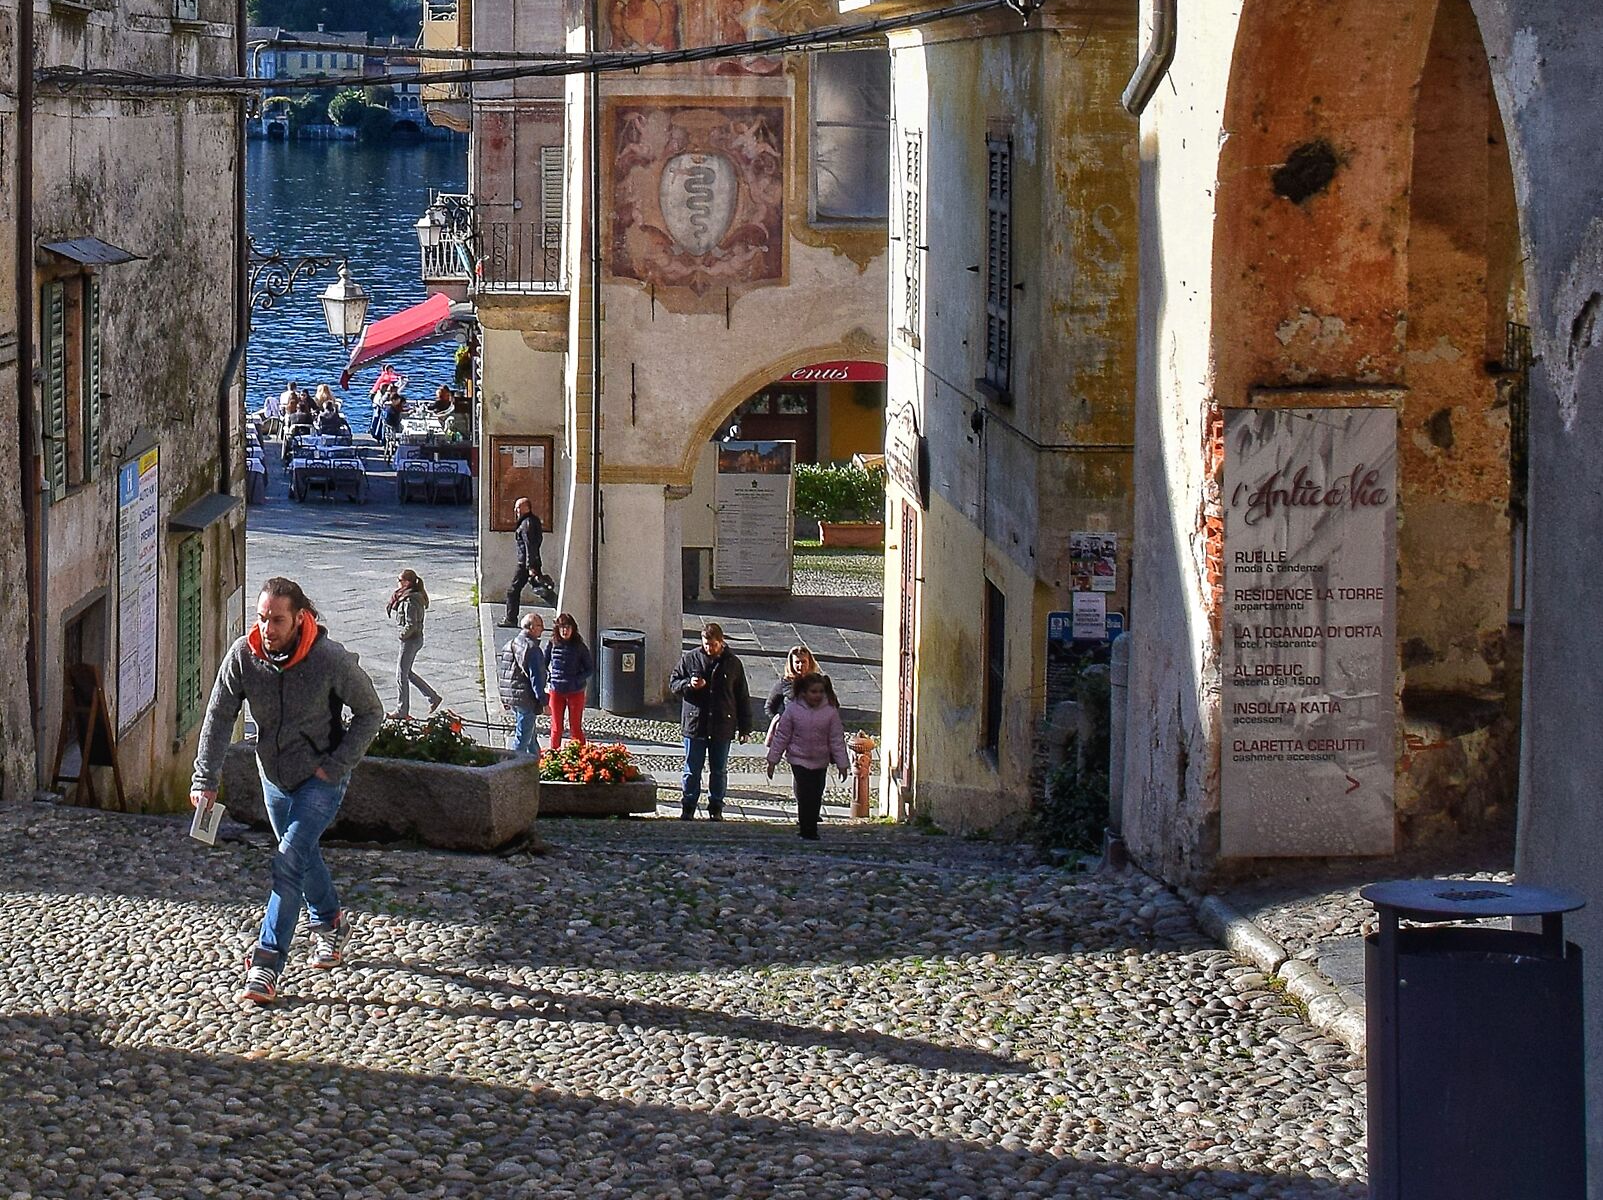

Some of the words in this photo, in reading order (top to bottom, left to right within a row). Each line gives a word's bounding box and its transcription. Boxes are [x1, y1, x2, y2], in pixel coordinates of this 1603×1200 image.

[791, 366, 849, 380] enus
[1231, 465, 1346, 526] l'Antica
[1334, 463, 1389, 511] Via
[1234, 551, 1288, 564] RUELLE
[1234, 564, 1262, 573] moda
[1265, 564, 1274, 573] &
[1277, 563, 1324, 573] tendenze
[1234, 589, 1313, 601] RESIDENCE
[1317, 589, 1334, 600] LA
[1338, 588, 1384, 600] TORRE
[1234, 602, 1305, 612] appartamenti
[1234, 627, 1251, 639] LA
[1255, 626, 1324, 639] LOCANDA
[1327, 626, 1341, 638] DI
[1344, 626, 1383, 638] ORTA
[1264, 640, 1318, 648] ristorante
[1233, 665, 1251, 677] AL
[1255, 665, 1303, 676] BOEUC
[1233, 677, 1270, 686] osteria
[1292, 677, 1321, 686] 1500
[1233, 703, 1297, 714] INSOLITA
[1300, 702, 1342, 714] KATIA
[1233, 716, 1283, 724] accessori
[1233, 740, 1302, 752] CLARETTA
[1307, 739, 1365, 751] CERUTTI
[1233, 753, 1284, 762] cashmere
[1286, 753, 1337, 761] accessori
